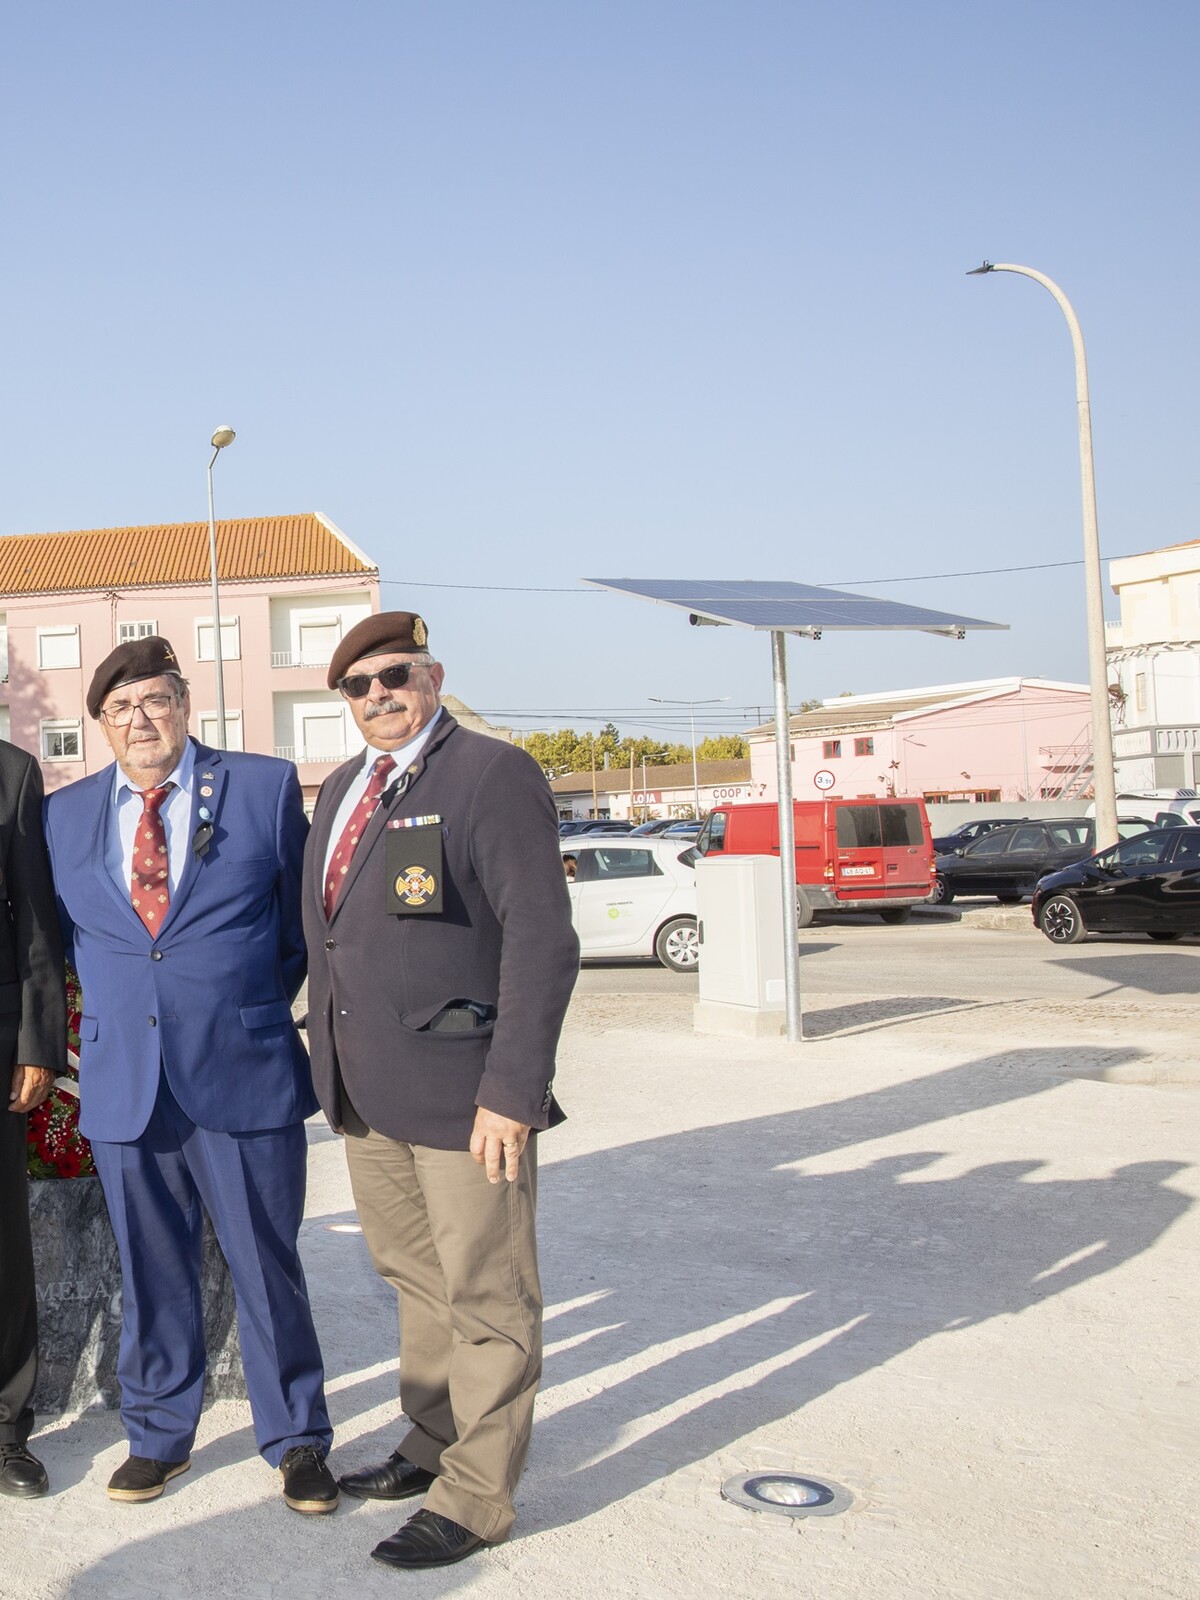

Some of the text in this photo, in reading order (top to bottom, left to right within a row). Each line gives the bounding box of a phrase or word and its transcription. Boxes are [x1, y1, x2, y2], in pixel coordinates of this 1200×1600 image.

[633, 793, 656, 804] LOJA
[712, 787, 742, 799] COOP
[35, 1279, 113, 1302] MELA
